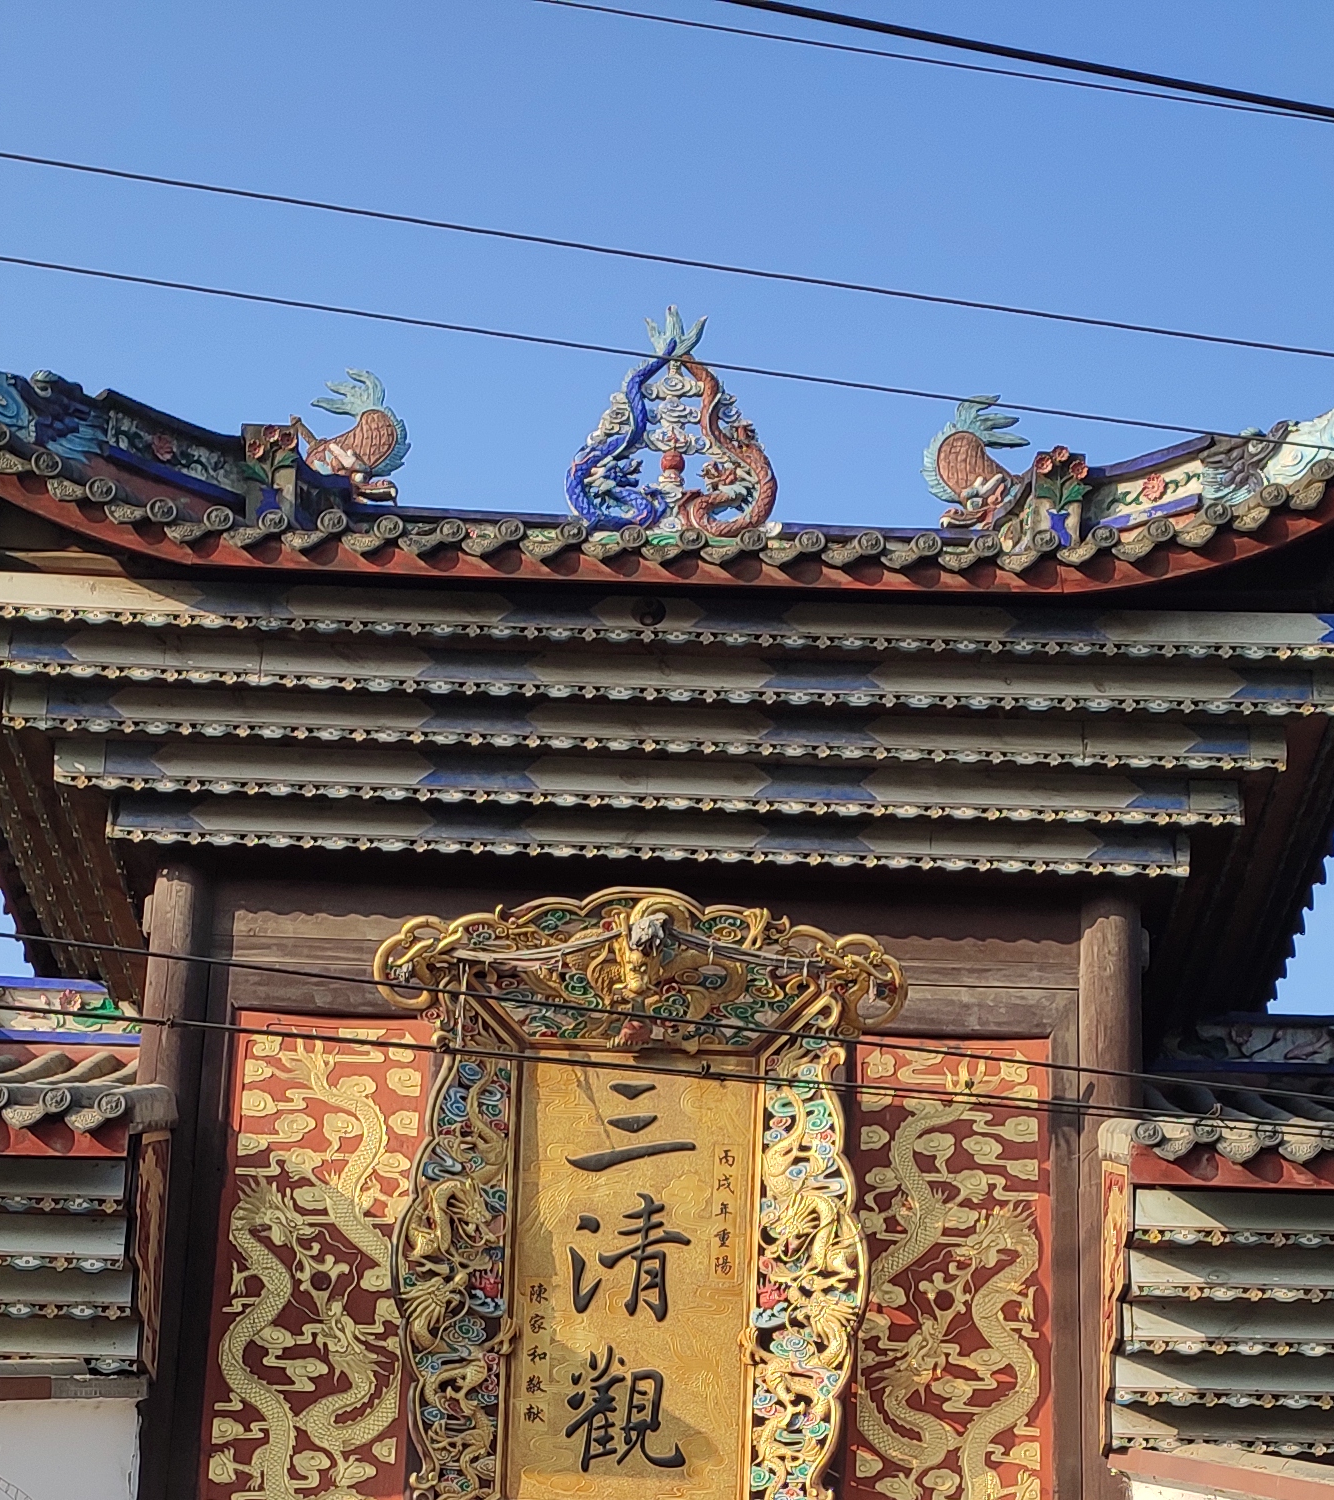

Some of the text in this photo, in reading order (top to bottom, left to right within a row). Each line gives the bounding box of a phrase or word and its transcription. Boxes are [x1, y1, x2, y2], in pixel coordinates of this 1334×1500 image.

[564, 1080, 696, 1473] 三清觀
[714, 1147, 736, 1277] 丙戌年重陽
